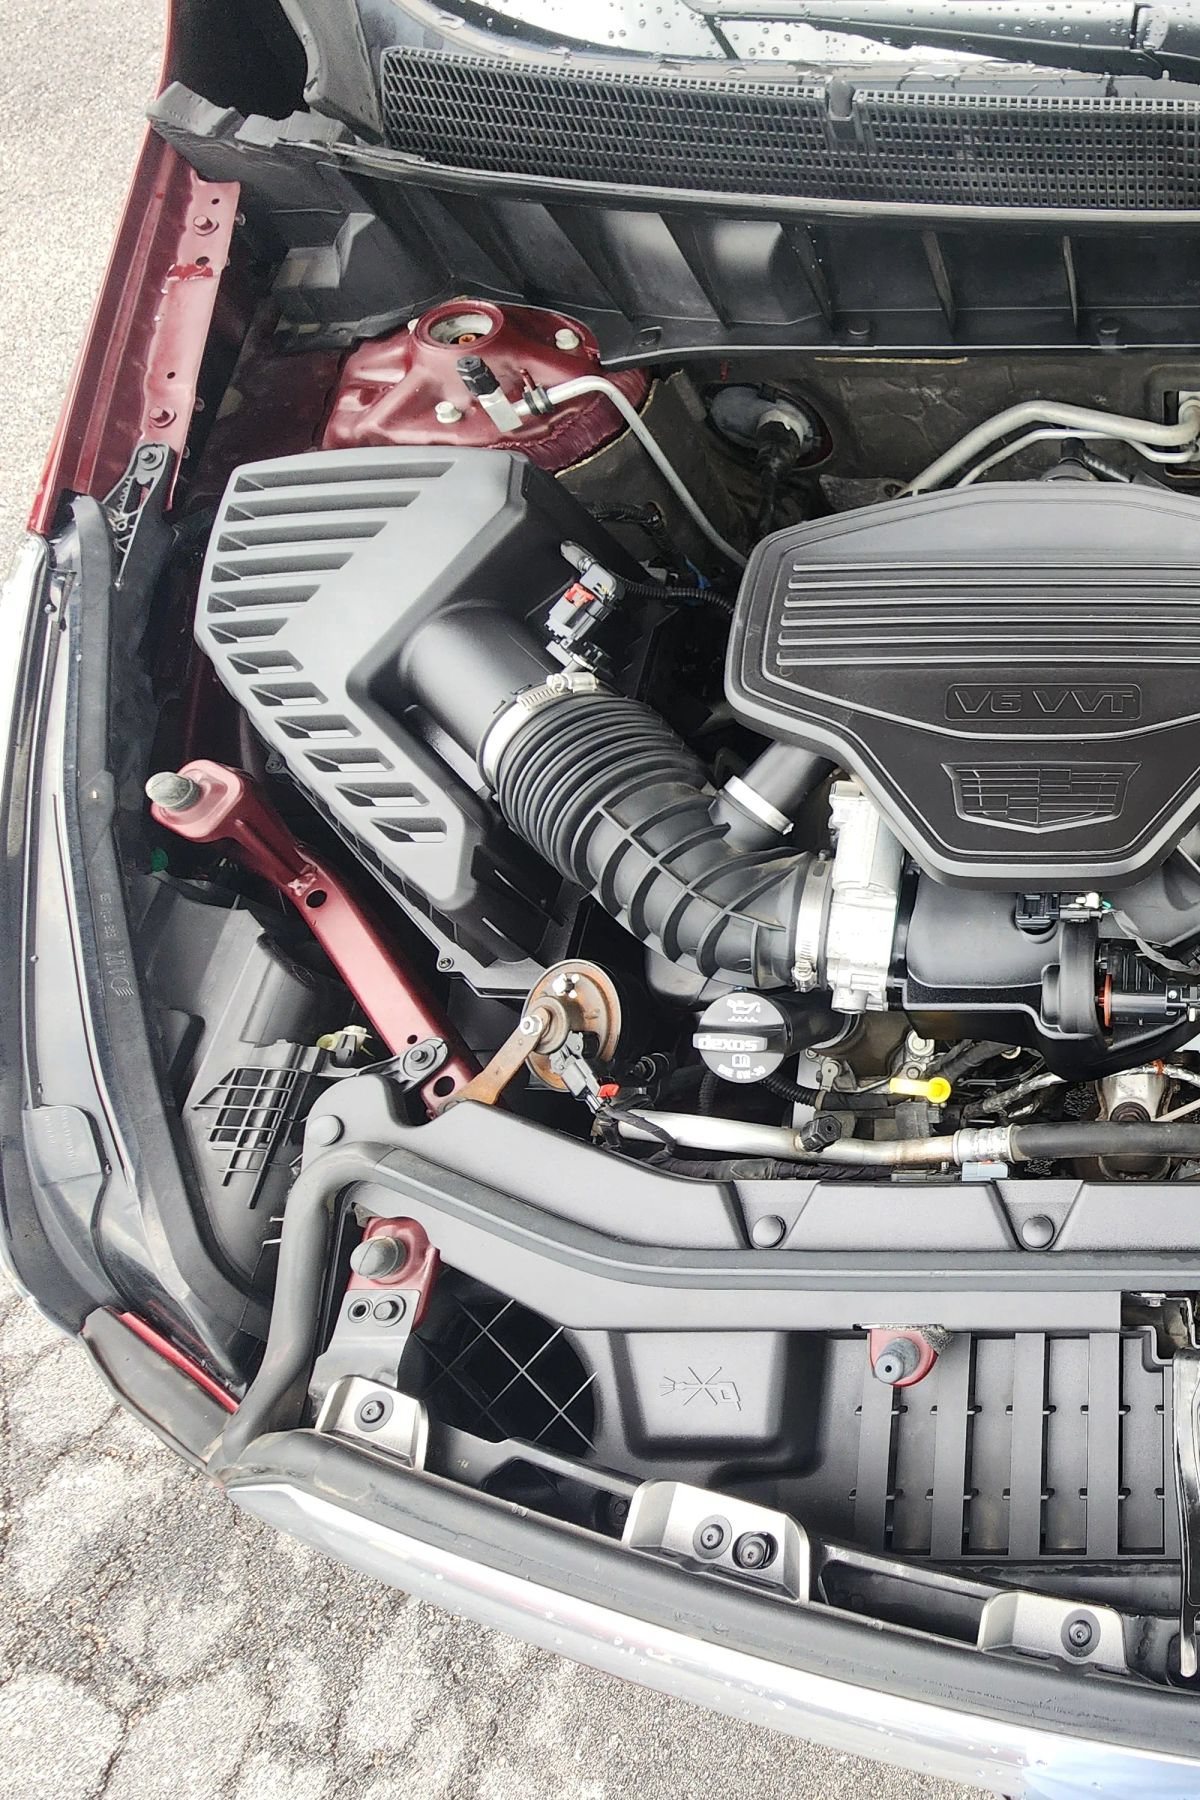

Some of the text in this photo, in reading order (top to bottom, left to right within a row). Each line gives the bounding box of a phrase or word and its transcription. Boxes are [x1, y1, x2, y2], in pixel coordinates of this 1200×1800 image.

[954, 690, 1134, 714] V6 VVT
[699, 1036, 758, 1051] dexos
